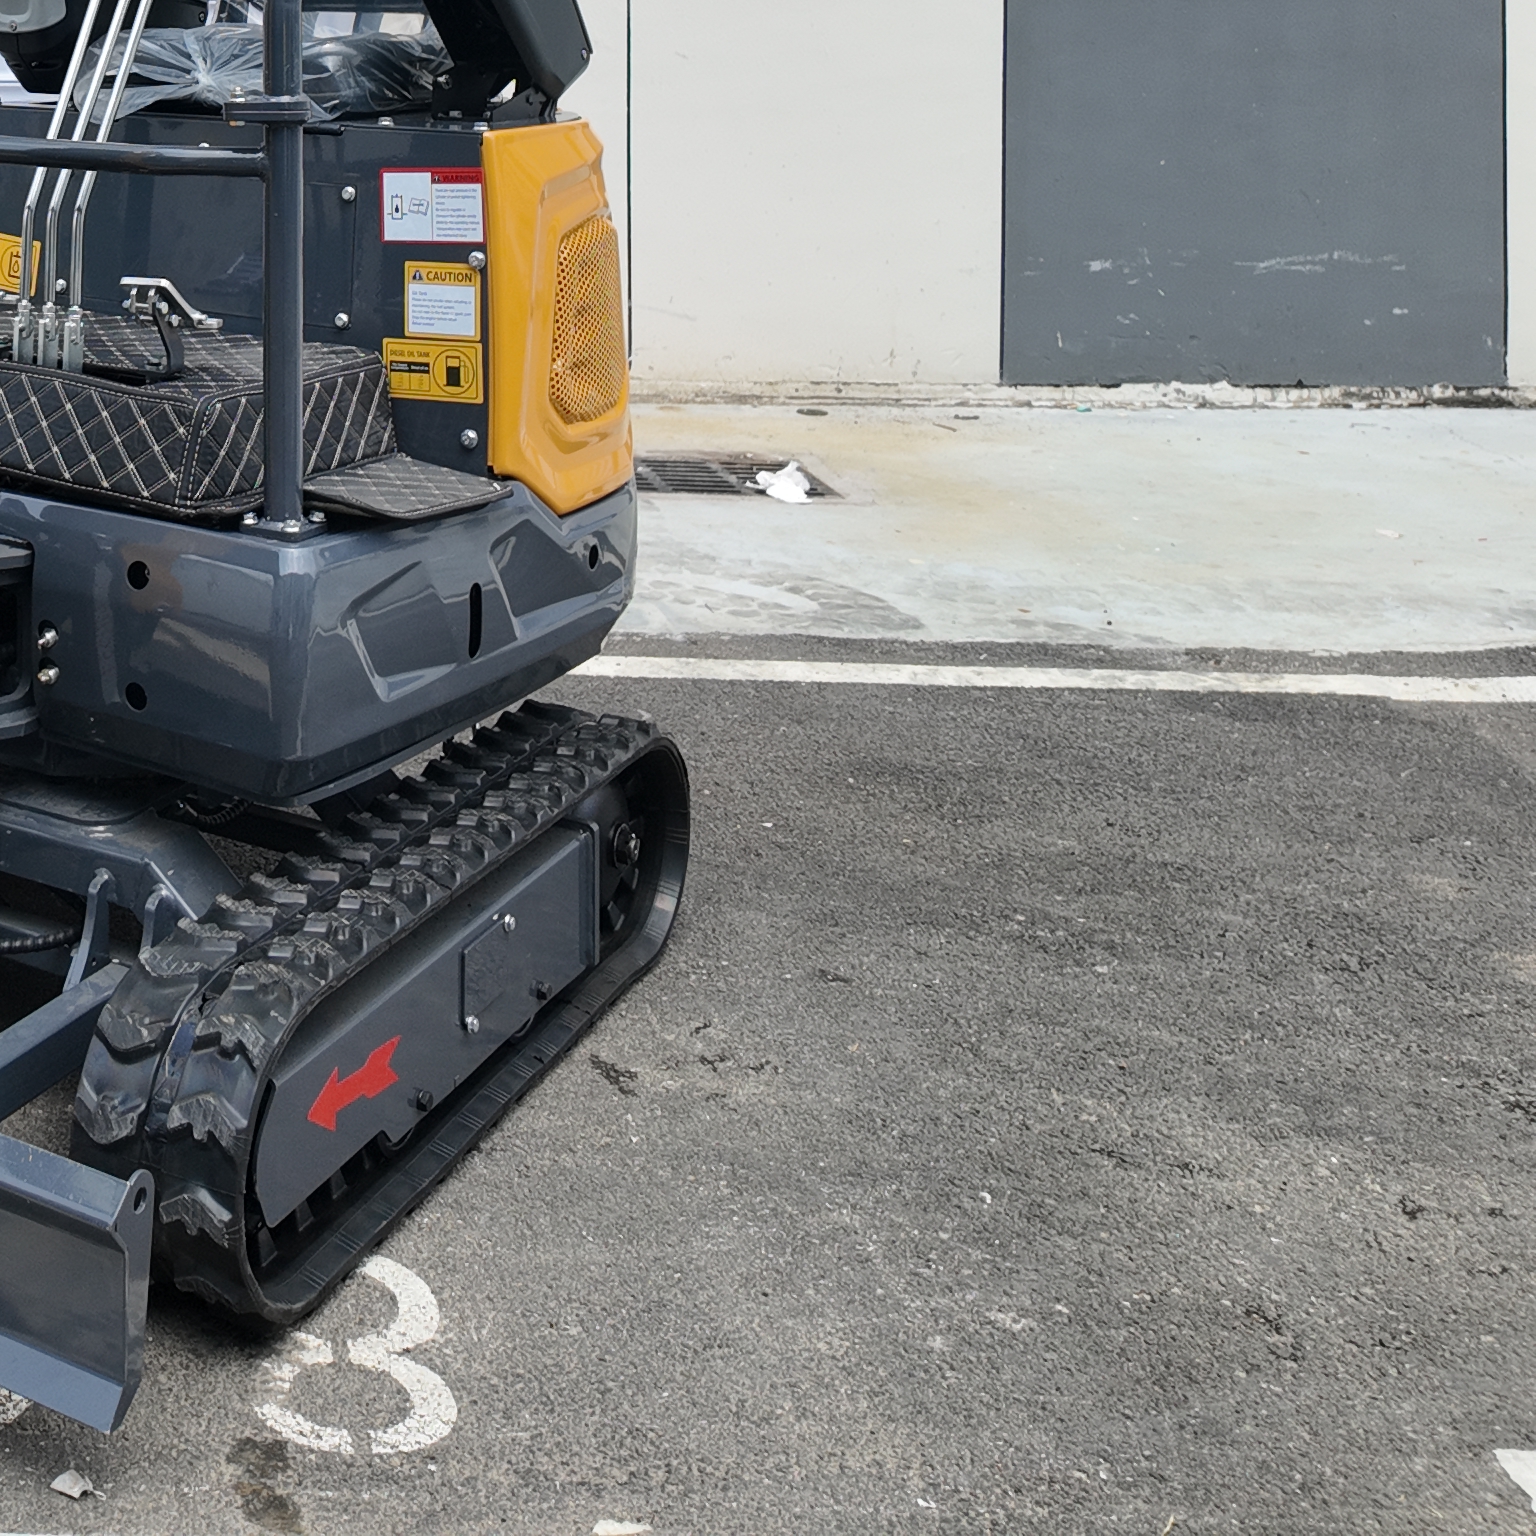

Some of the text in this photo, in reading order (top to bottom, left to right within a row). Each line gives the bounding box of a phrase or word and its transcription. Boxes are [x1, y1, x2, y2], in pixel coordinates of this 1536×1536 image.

[441, 174, 480, 183] WARNING
[426, 270, 473, 283] CAUTION
[407, 349, 415, 358] OIL
